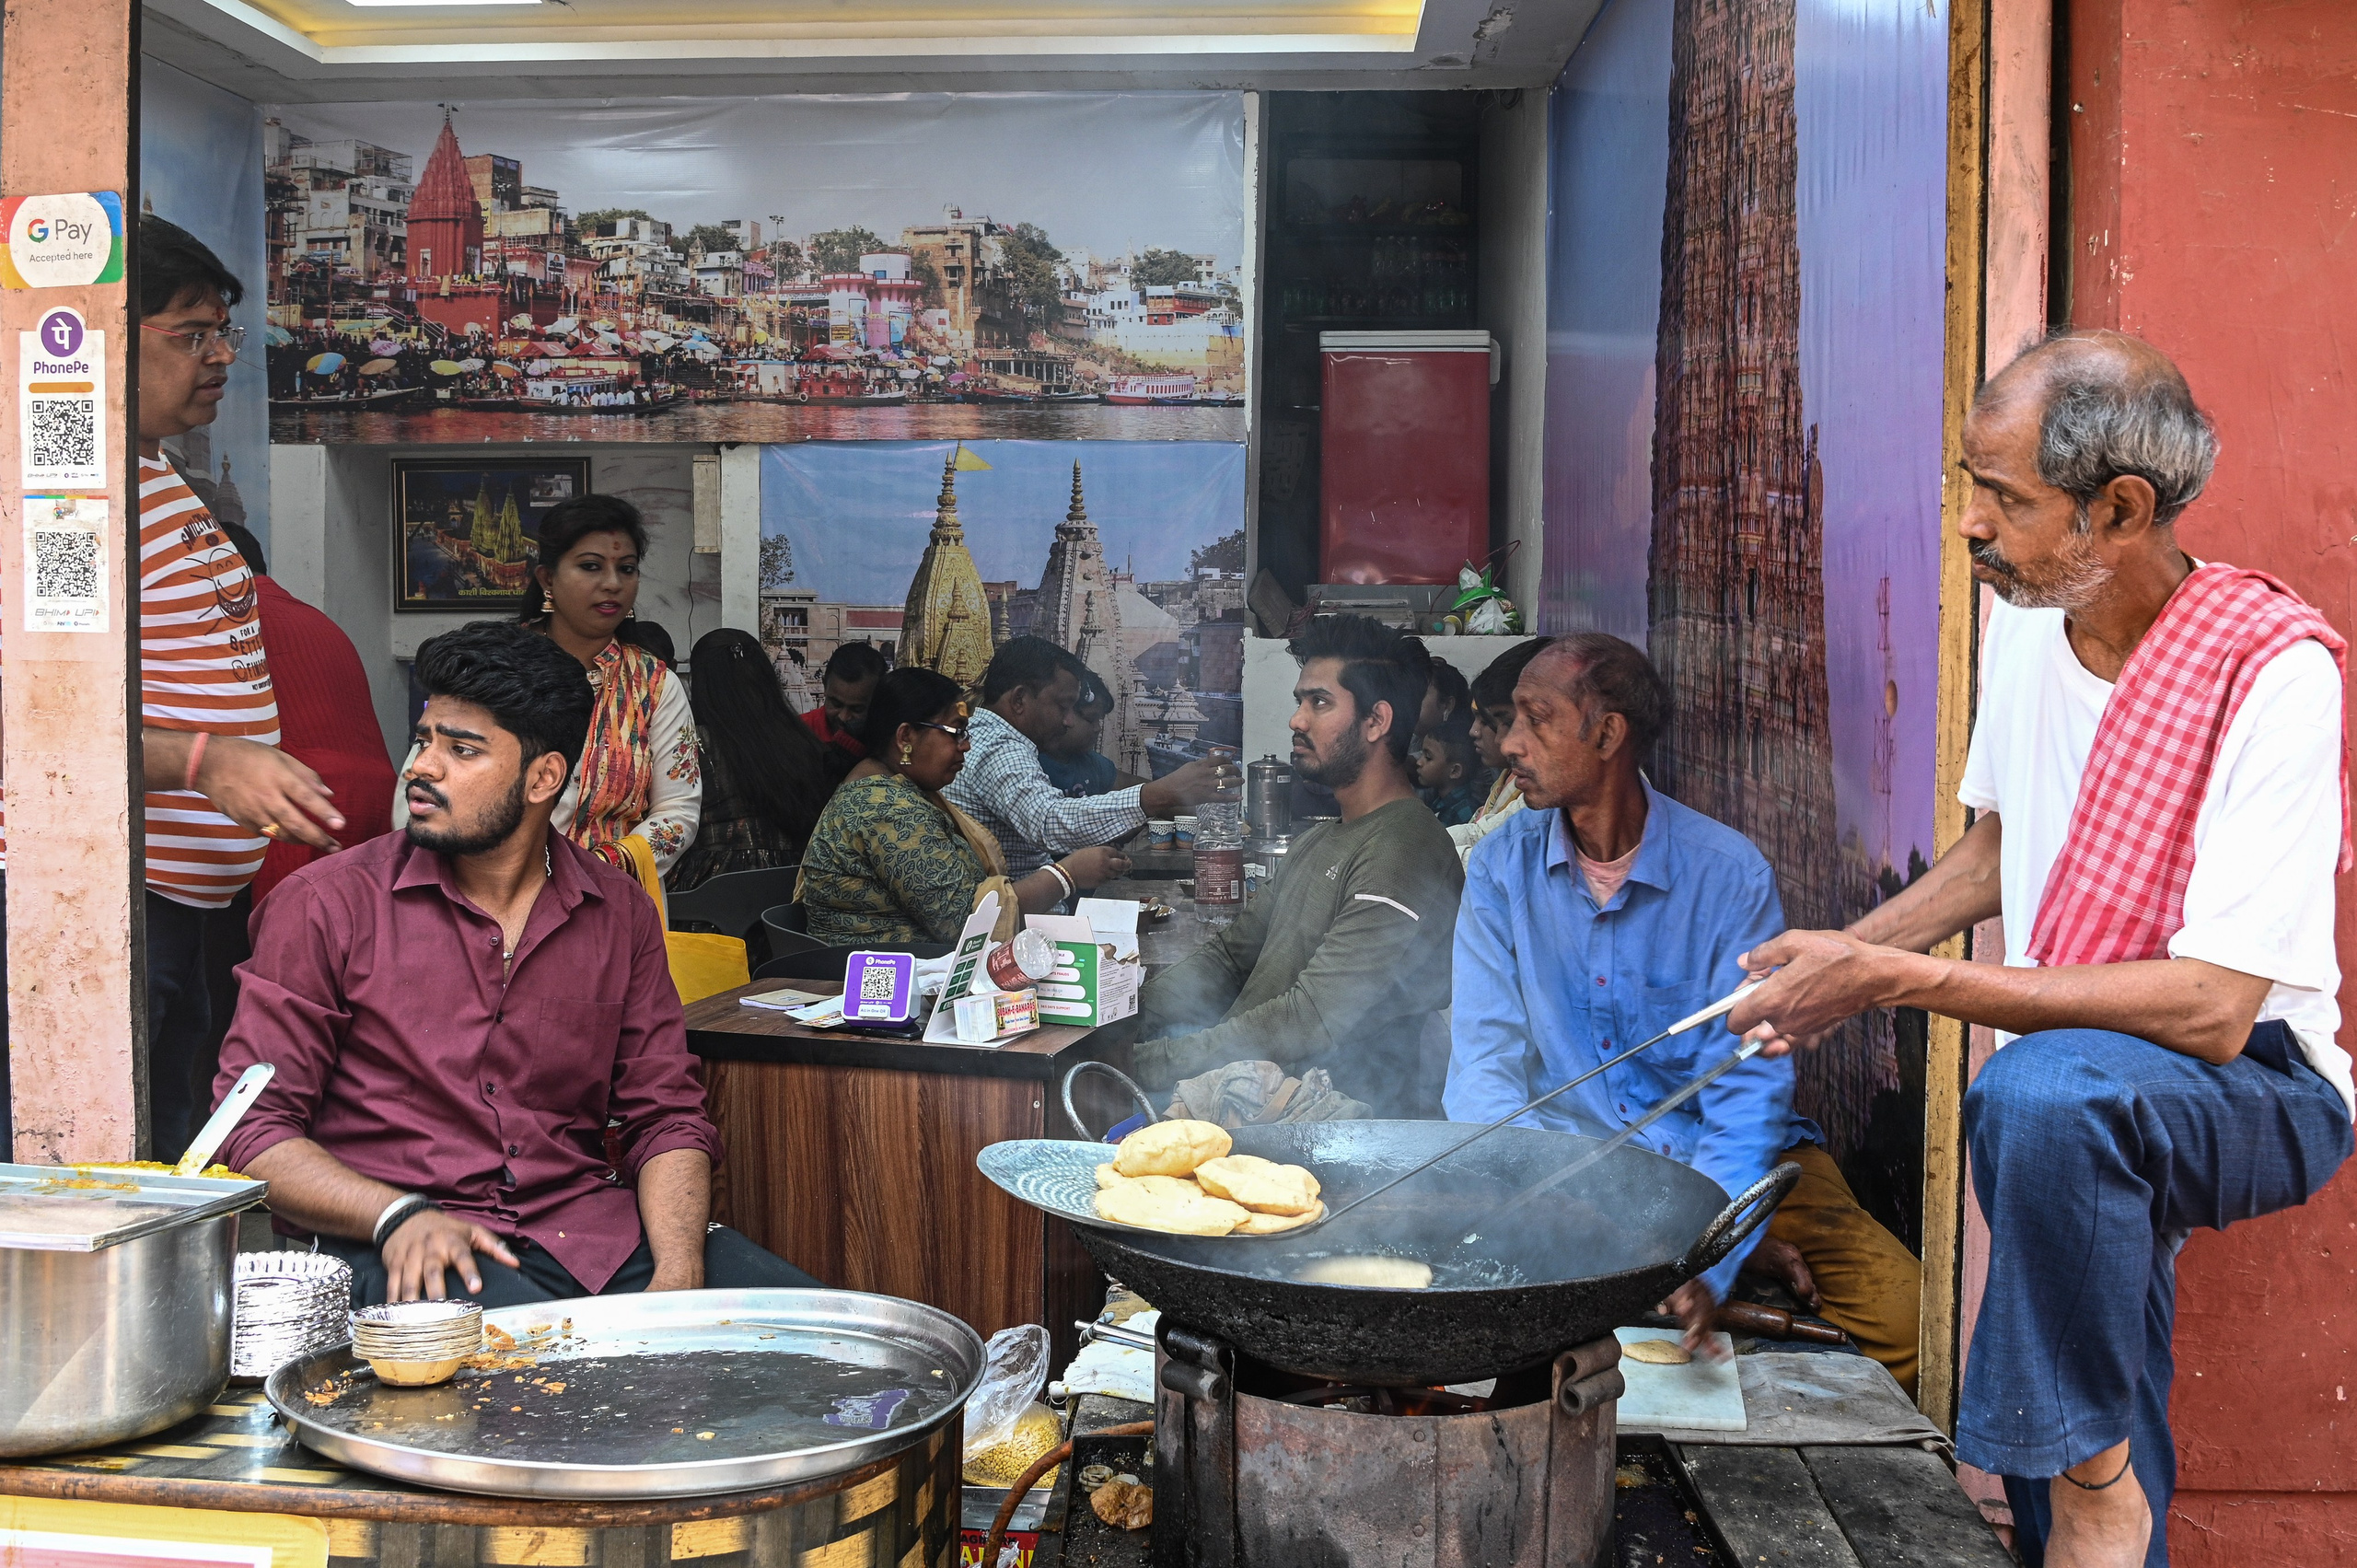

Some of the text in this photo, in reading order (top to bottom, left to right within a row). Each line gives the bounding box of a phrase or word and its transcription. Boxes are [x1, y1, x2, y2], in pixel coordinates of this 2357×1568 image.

[28, 218, 92, 245] G Pay
[29, 250, 93, 263] Accepted here
[33, 360, 89, 375] PhonePe
[35, 608, 96, 617] BHIM UPI
[240, 627, 250, 637] FOR
